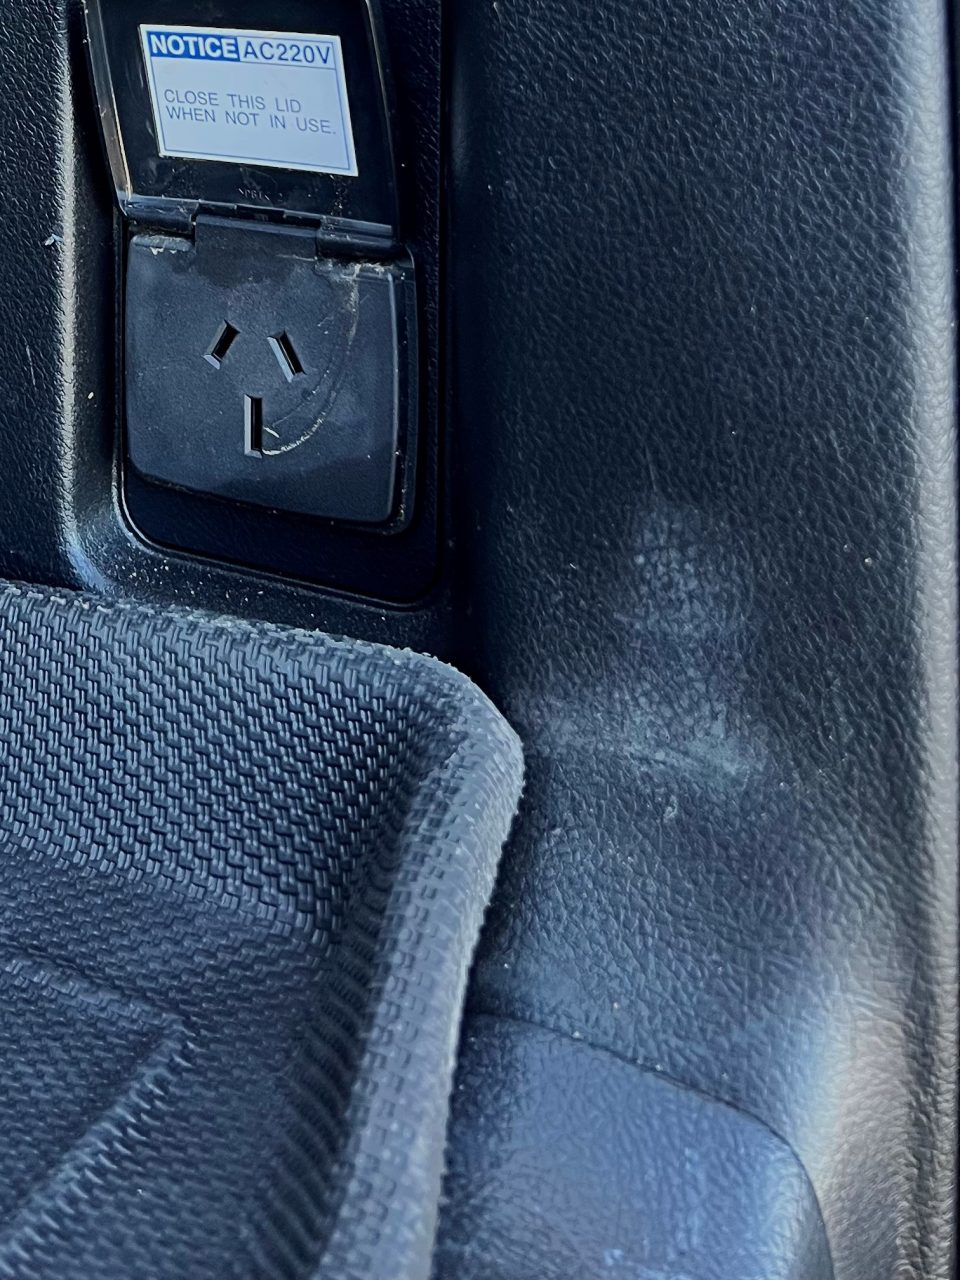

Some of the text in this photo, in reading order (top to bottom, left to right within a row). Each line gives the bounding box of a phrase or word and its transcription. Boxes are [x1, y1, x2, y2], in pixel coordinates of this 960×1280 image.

[150, 34, 330, 64] NOTICE AC220V
[164, 89, 301, 113] CLOSE THIS LID
[166, 105, 336, 134] WHEN NOT IN USE.
